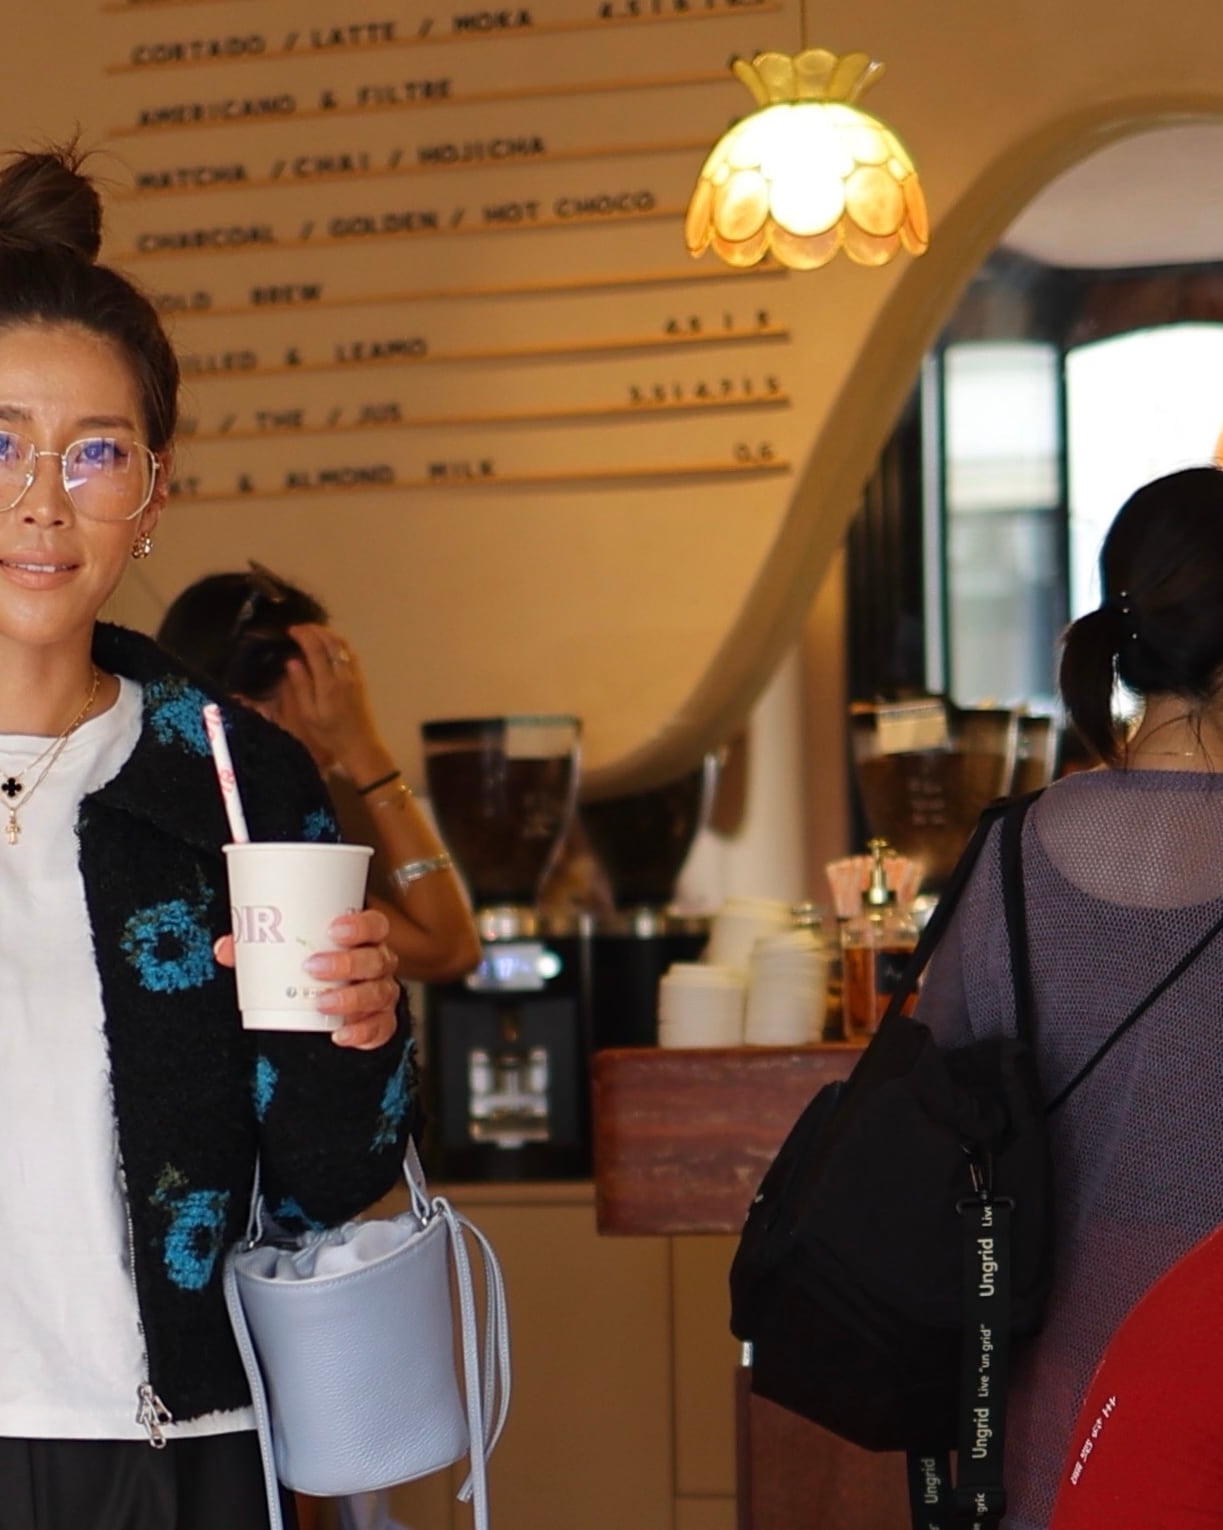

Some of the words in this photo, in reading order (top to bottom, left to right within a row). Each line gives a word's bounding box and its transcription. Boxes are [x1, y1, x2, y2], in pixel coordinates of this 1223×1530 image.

[133, 34, 265, 65] CORTADO
[312, 22, 395, 49] LATTE
[455, 11, 531, 32] MOKA
[139, 95, 295, 126] AMERICANO
[320, 88, 337, 110] &
[359, 77, 451, 104] FILTRE
[138, 164, 247, 188] MATCHA
[139, 226, 273, 251] CHARCOAL
[330, 210, 438, 237] GOLDEN
[484, 202, 539, 222] HOT
[556, 193, 654, 217] CHOCO
[252, 284, 322, 306] BREW
[288, 465, 394, 488] ALMOND
[431, 459, 493, 480] MILK
[977, 1238, 998, 1297] Ungrid
[978, 1375, 990, 1397] Live
[971, 1408, 992, 1459] Ungrid
[921, 1457, 941, 1504] Ungrid
